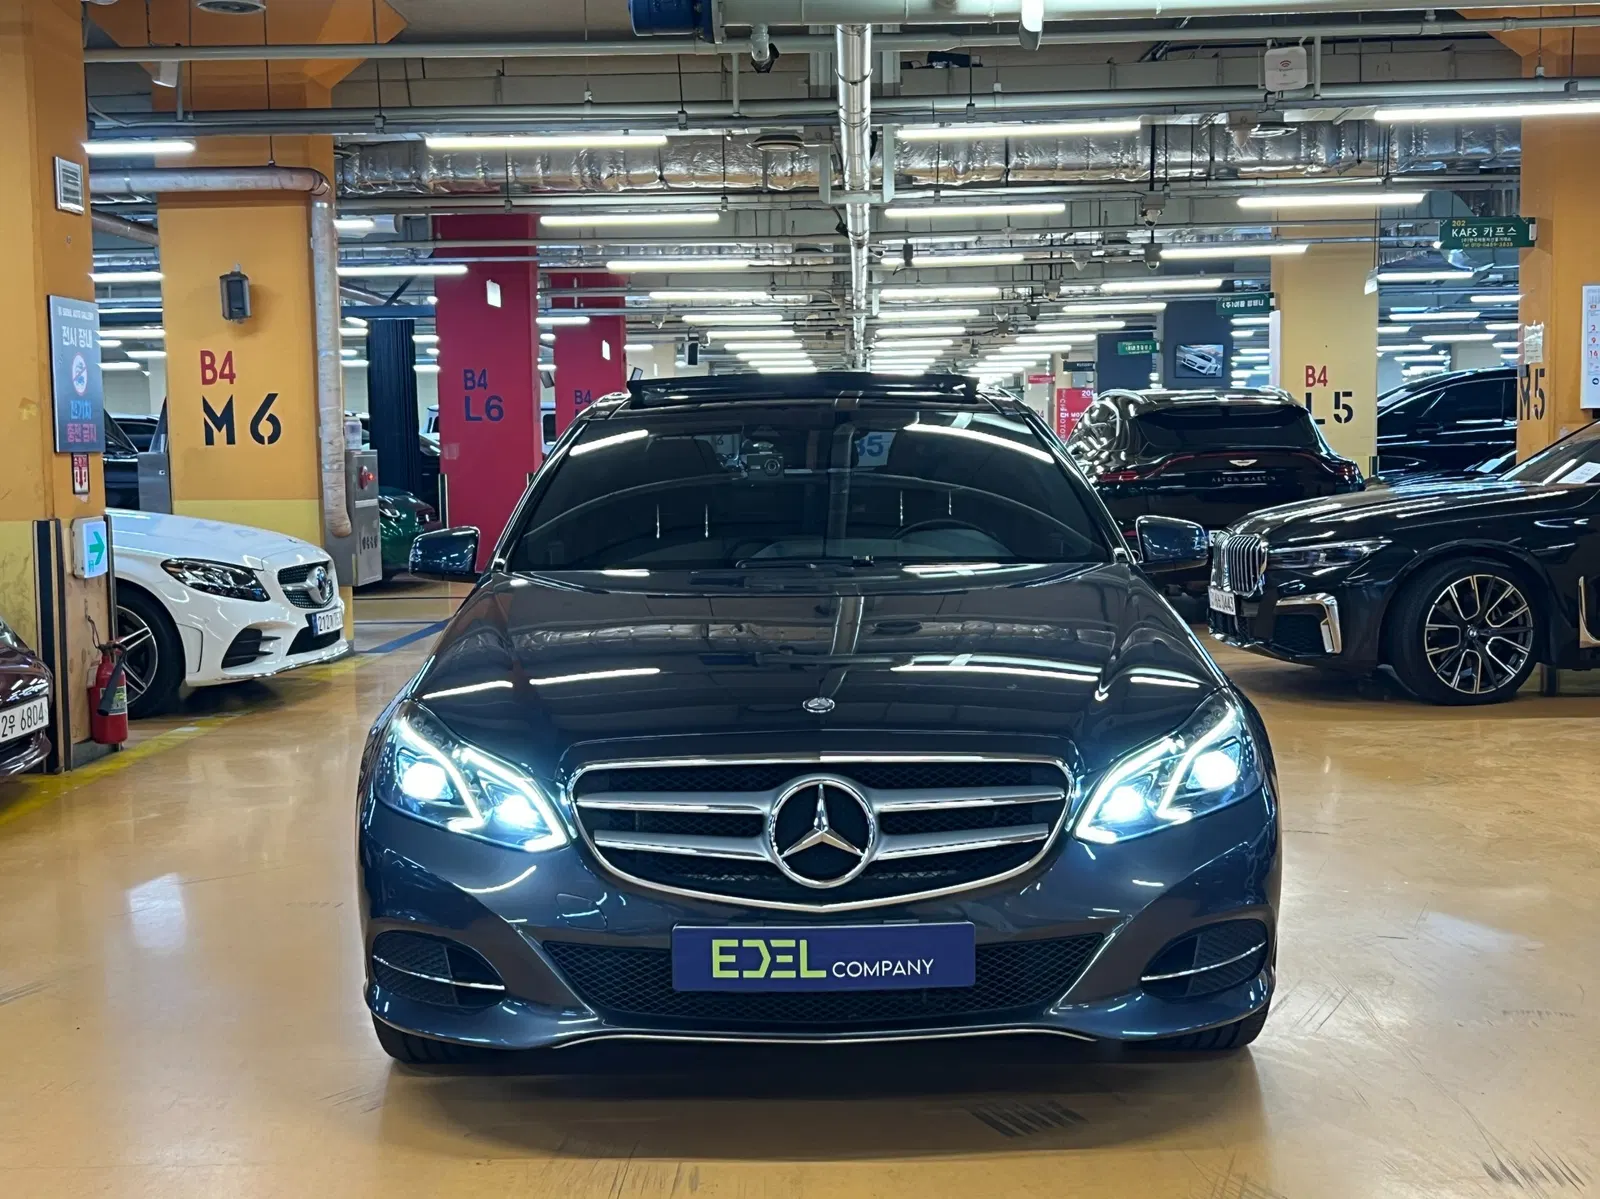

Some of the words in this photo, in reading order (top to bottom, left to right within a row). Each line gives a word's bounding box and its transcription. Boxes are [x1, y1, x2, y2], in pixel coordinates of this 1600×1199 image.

[1451, 228, 1477, 238] KAFS
[61, 325, 77, 347] 전시
[200, 350, 236, 386] B4
[463, 368, 488, 391] B4
[1305, 365, 1329, 388] B4
[464, 395, 504, 422] L6
[574, 389, 592, 405] B4
[20, 702, 44, 731] 6804
[712, 938, 827, 978] EDEL
[832, 958, 934, 978] COMPANY
